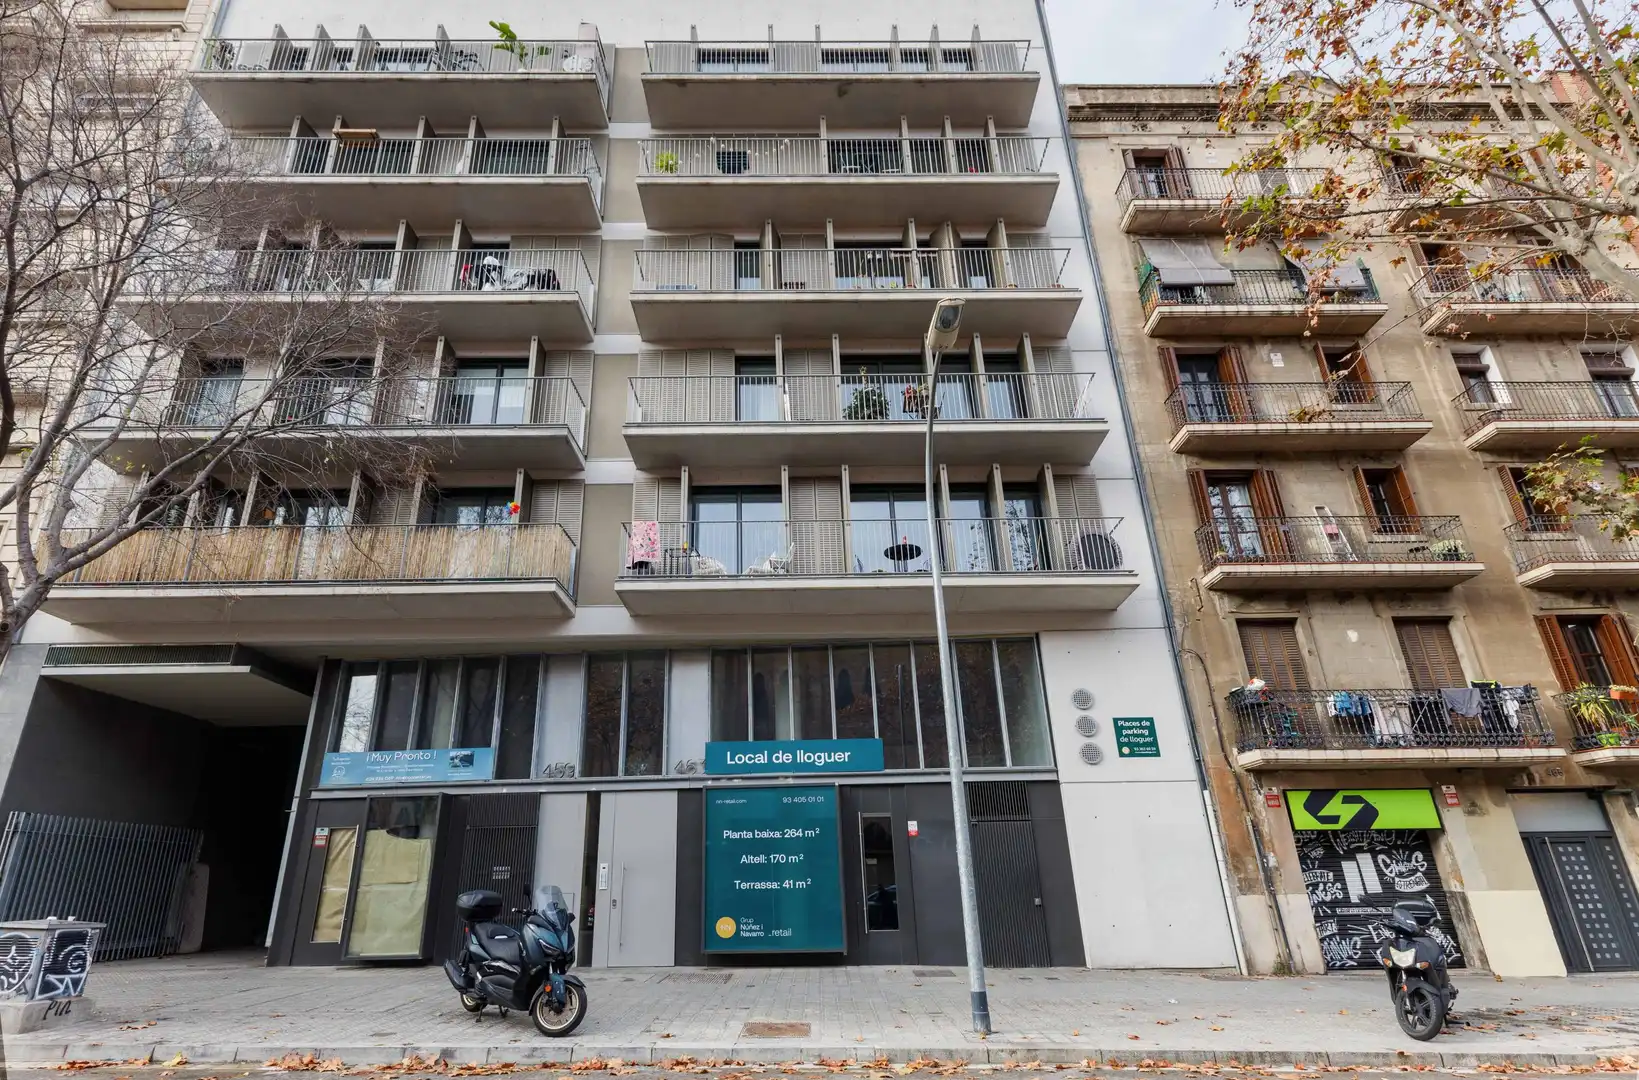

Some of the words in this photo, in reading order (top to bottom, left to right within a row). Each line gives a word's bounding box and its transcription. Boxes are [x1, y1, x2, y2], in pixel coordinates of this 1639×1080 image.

[1130, 736, 1154, 744] lloguer
[395, 751, 431, 760] Pronto
[727, 751, 768, 765] Local
[772, 751, 792, 764] de
[797, 750, 851, 766] lloguer
[723, 830, 753, 838] Planta
[754, 829, 782, 838] baixa:
[784, 828, 803, 838] 264
[740, 854, 768, 864] Altell:
[770, 854, 786, 863] 170
[734, 880, 780, 890] Terrassa:
[782, 880, 794, 888] 41
